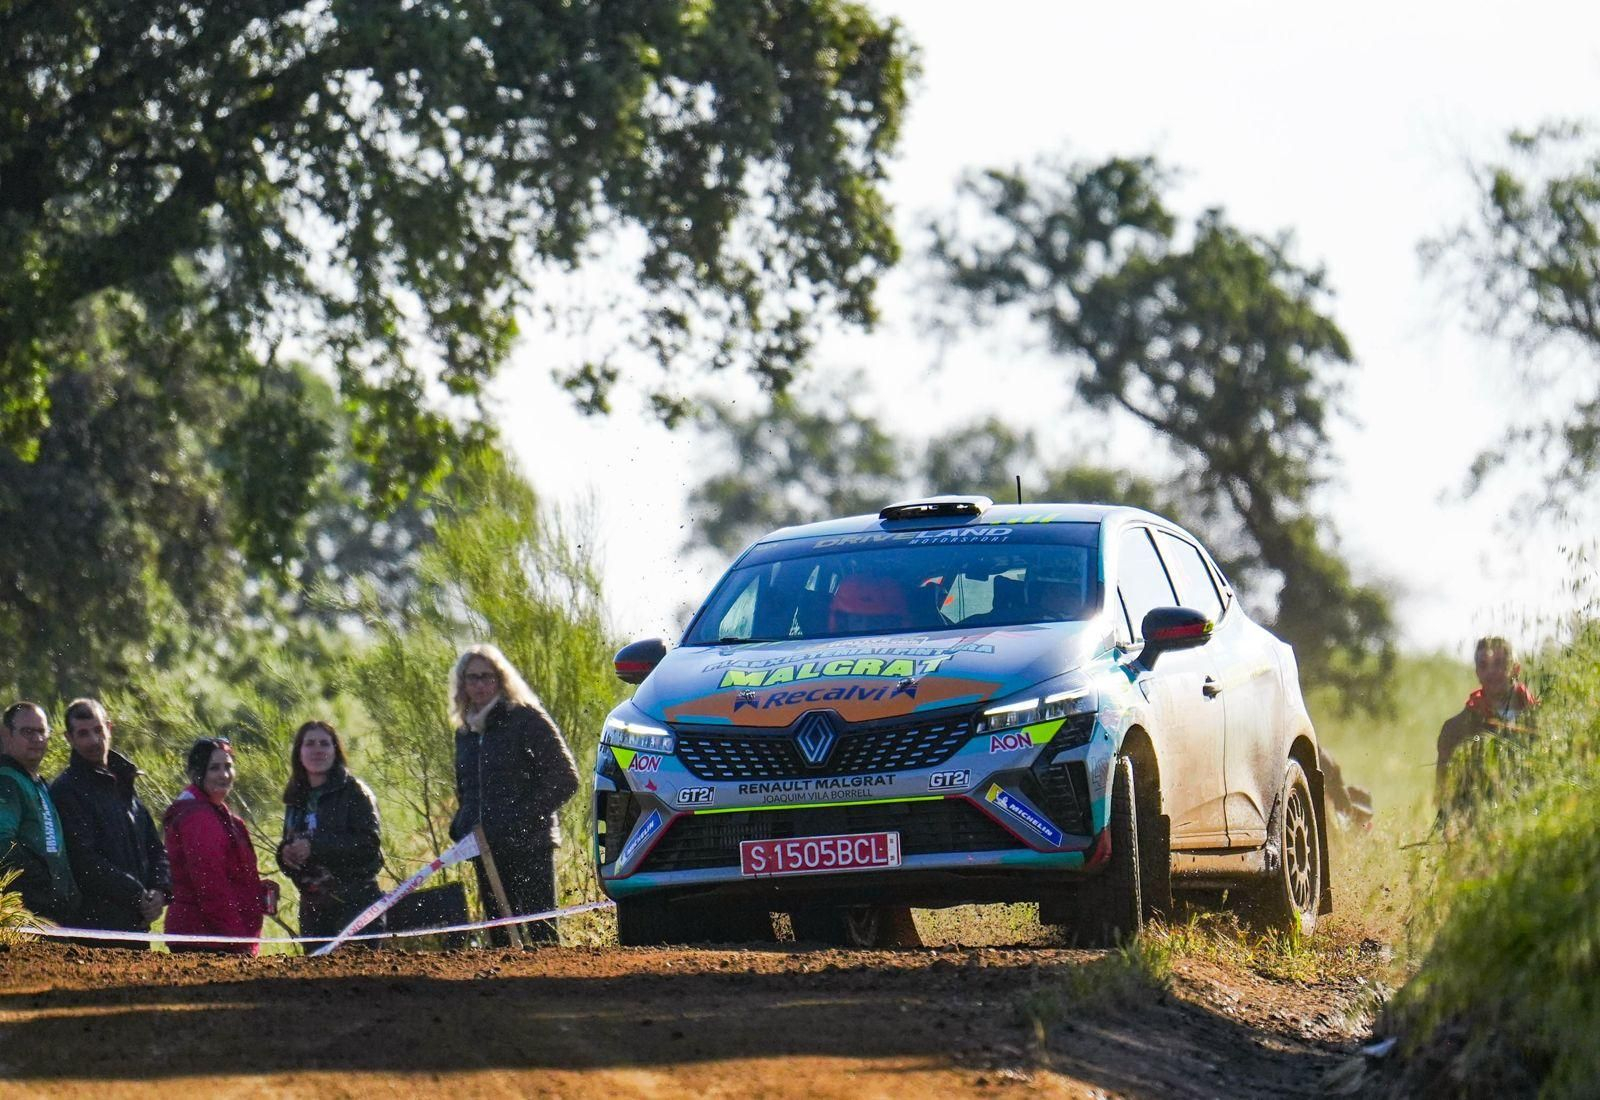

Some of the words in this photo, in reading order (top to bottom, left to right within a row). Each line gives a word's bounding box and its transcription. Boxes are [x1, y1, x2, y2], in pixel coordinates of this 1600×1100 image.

[814, 527, 1014, 549] DRIVELAND
[908, 536, 1009, 545] MOTORSPORT
[717, 654, 954, 689] MALGRAT
[762, 684, 888, 709] Recalvi
[990, 732, 1033, 754] AON
[627, 754, 662, 772] AON
[739, 780, 813, 795] RENAULT
[815, 774, 897, 790] MALGRAT
[762, 794, 806, 804] JOAQUIM
[807, 791, 829, 801] VILA
[831, 788, 873, 800] BORRELL
[1008, 803, 1053, 836] MICHELIN
